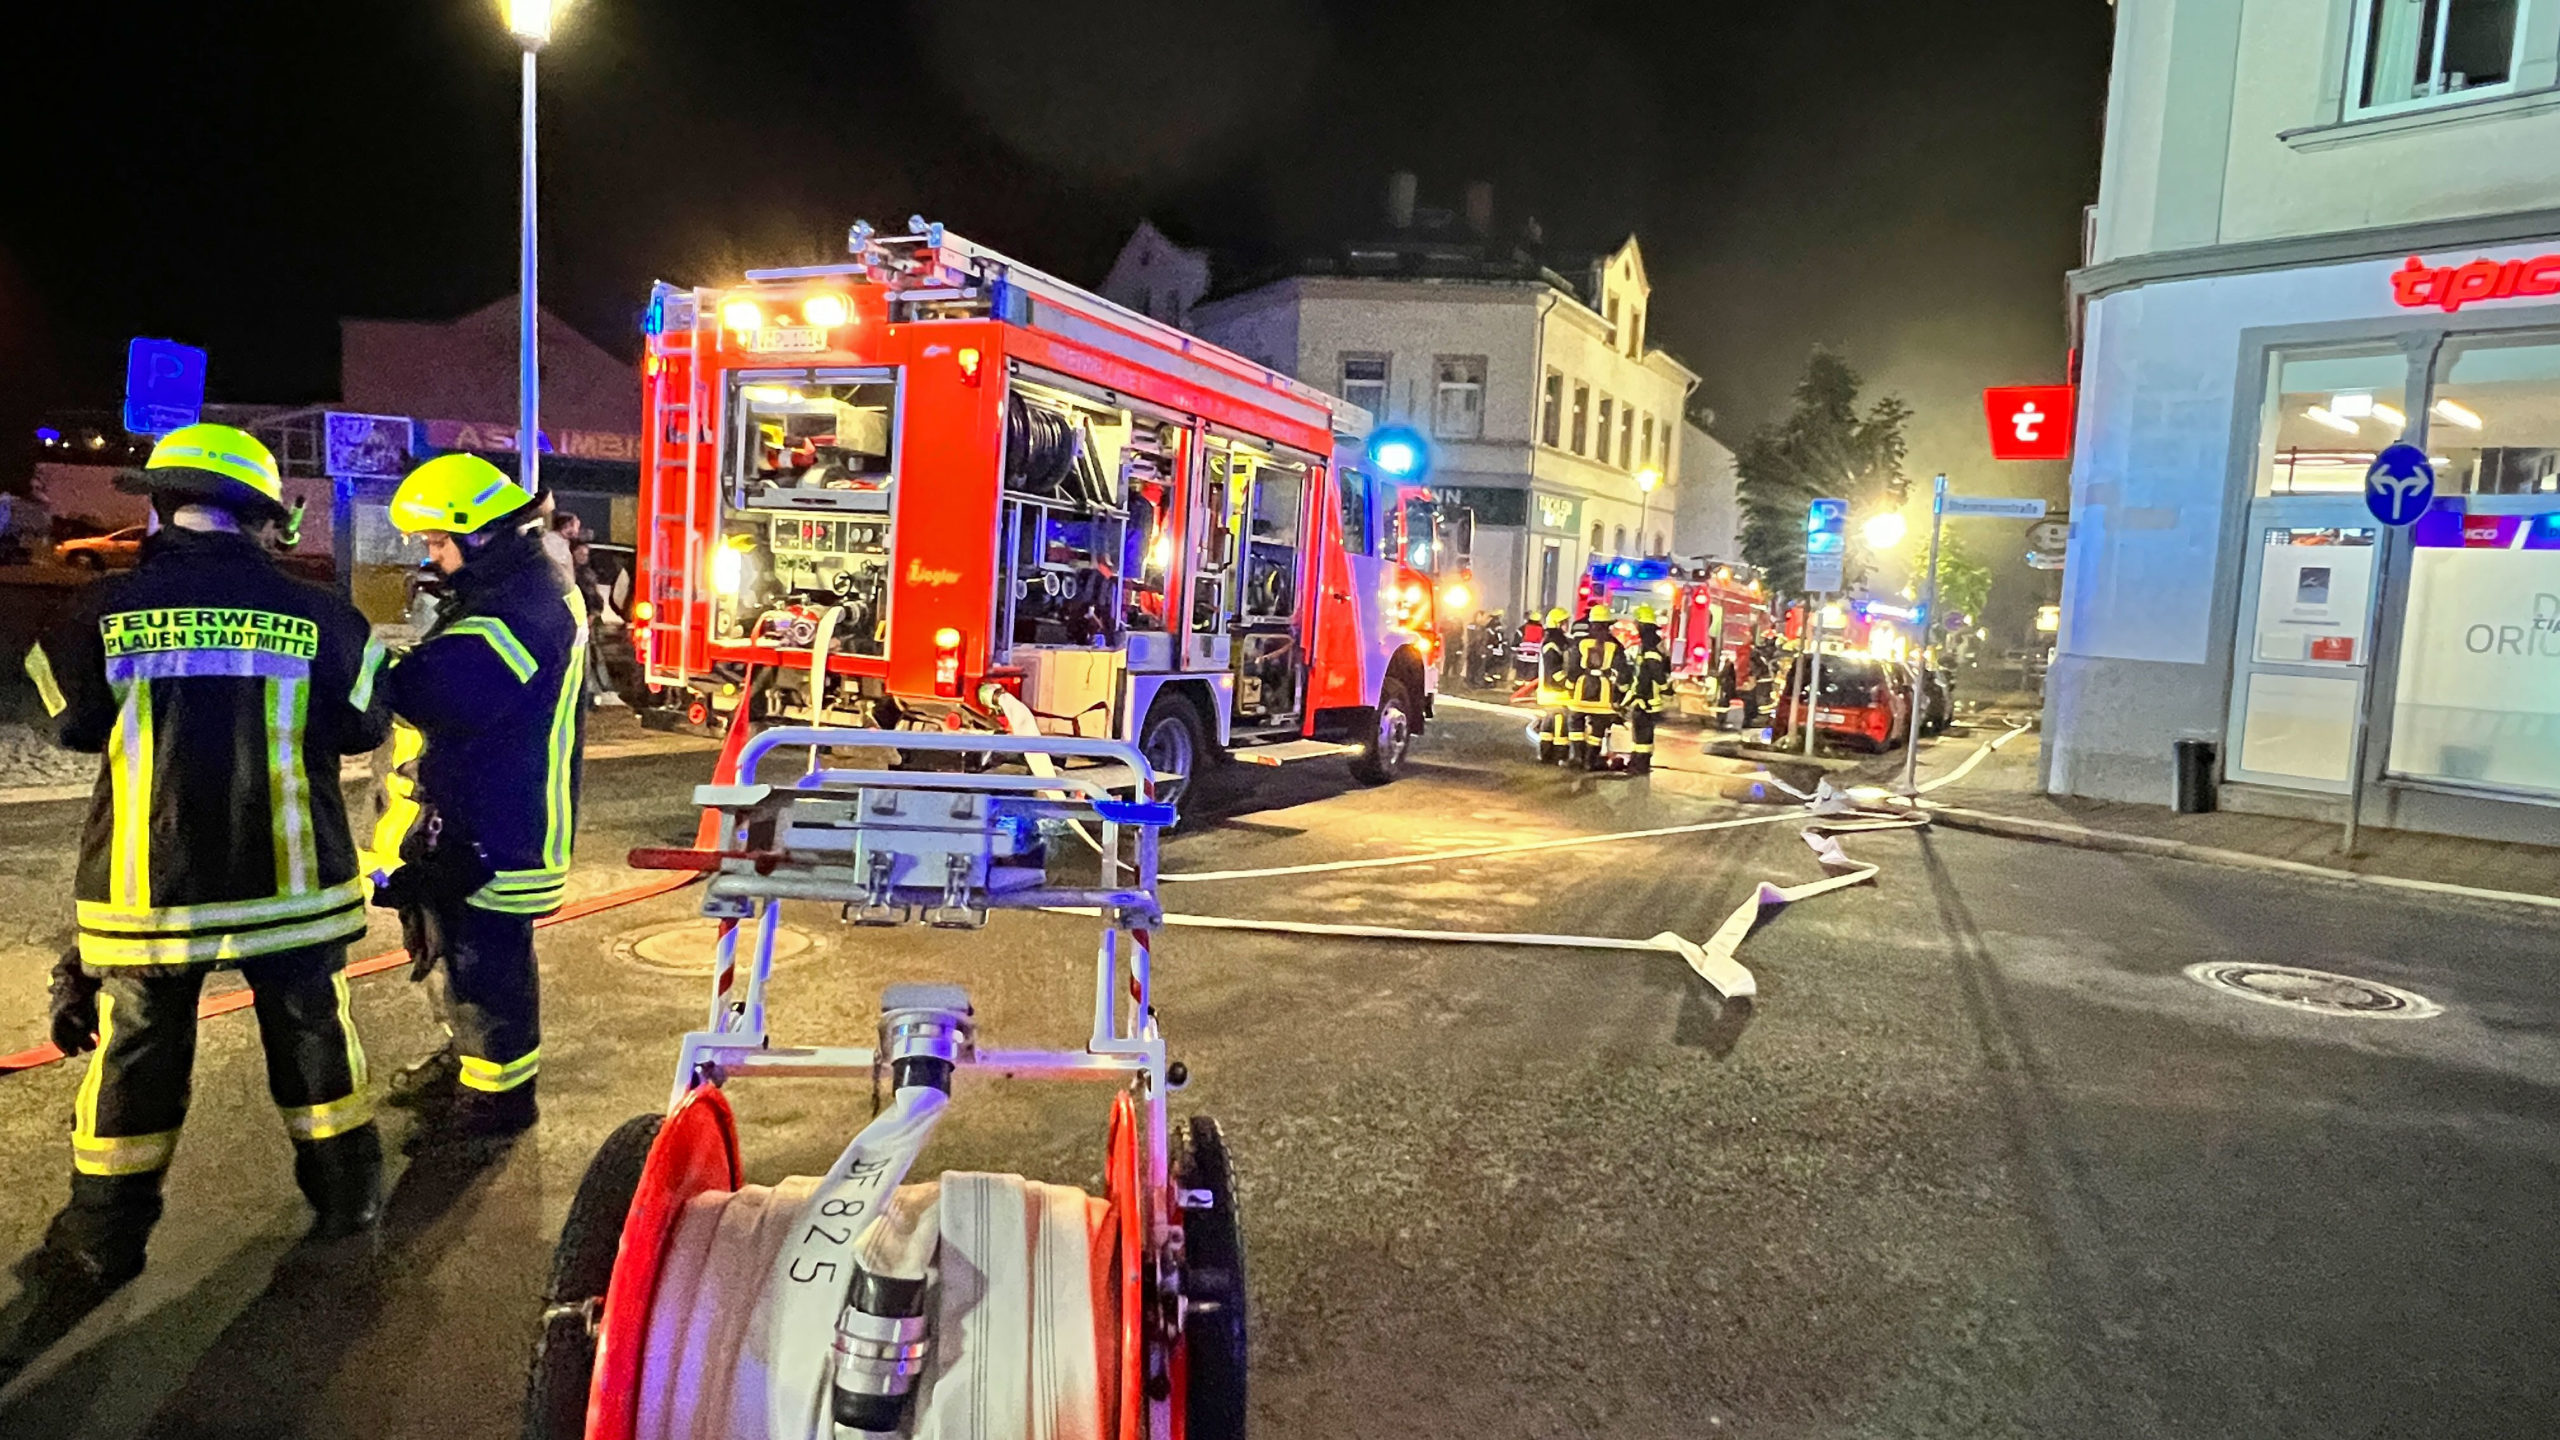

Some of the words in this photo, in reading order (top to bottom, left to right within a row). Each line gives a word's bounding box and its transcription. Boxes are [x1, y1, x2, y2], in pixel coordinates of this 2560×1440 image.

[147, 351, 185, 390] P
[2011, 401, 2046, 442] t
[1820, 504, 1839, 530] P
[102, 610, 315, 639] FEUERWEHR
[105, 631, 187, 654] PLAUEN
[194, 629, 315, 657] STADTMITTE
[788, 1198, 865, 1284] 825
